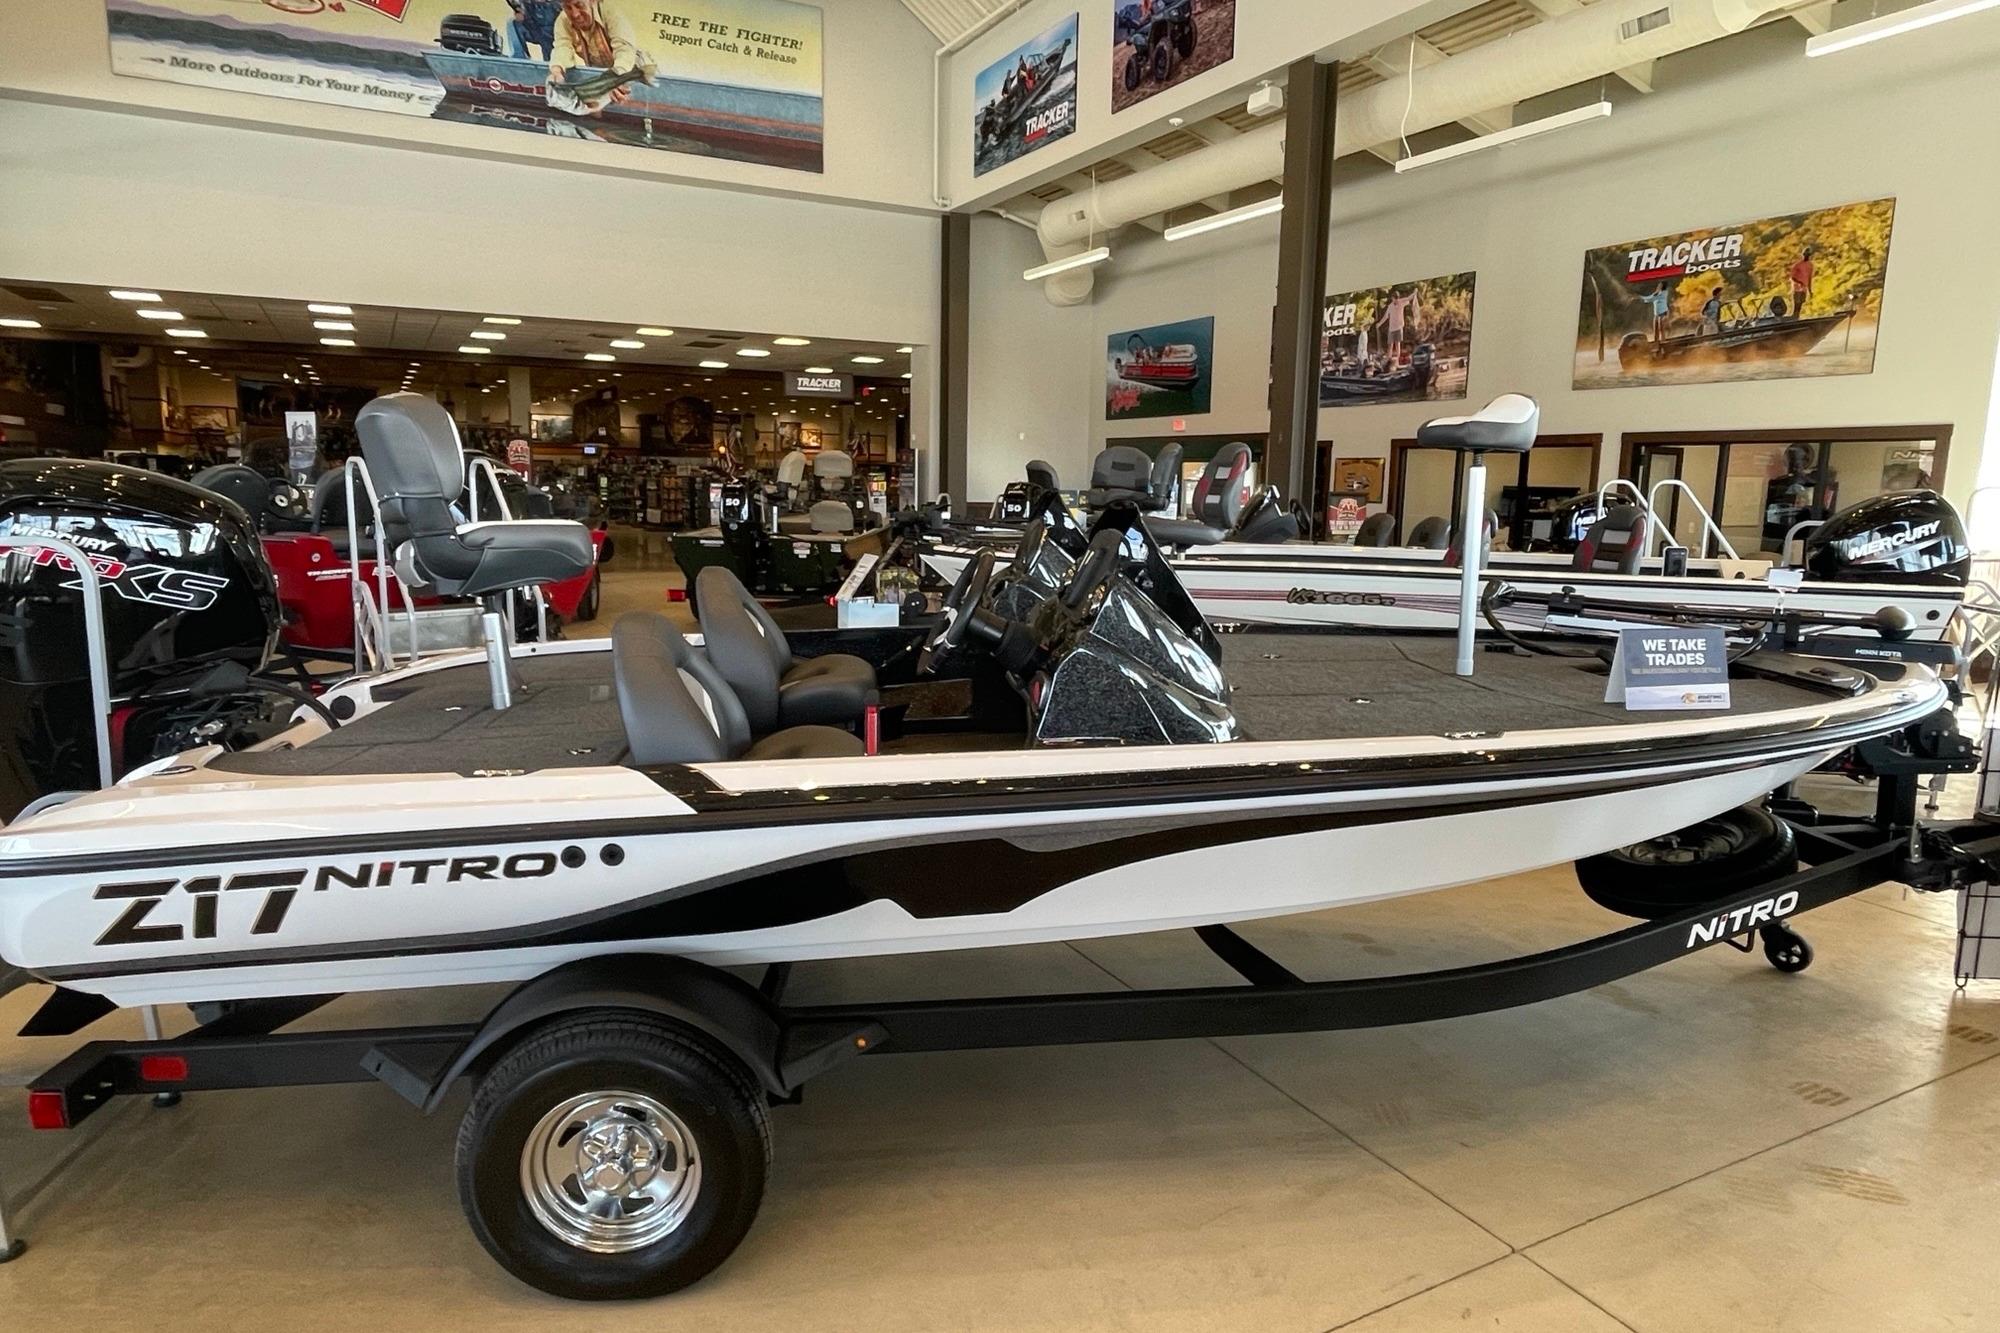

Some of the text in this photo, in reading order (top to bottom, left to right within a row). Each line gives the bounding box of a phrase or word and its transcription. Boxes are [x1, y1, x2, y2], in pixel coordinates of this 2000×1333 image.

[651, 12, 804, 51] FREE THE FIGHTER!
[658, 29, 798, 65] Support Catch & Release
[169, 56, 416, 102] More Outdoors For Your Money
[1026, 101, 1069, 136] TRACKER
[1628, 233, 1744, 273] TRACKER
[1685, 259, 1742, 274] boats
[797, 377, 842, 388] TRACKER
[725, 498, 740, 507] 50
[1007, 503, 1022, 513] 50
[1847, 520, 1941, 561] MERCURY
[1642, 638, 1707, 651] WE TAKE
[1645, 652, 1706, 666] TRADES
[93, 852, 558, 946] Z17 NITRO
[1686, 890, 1799, 948] NITRO
